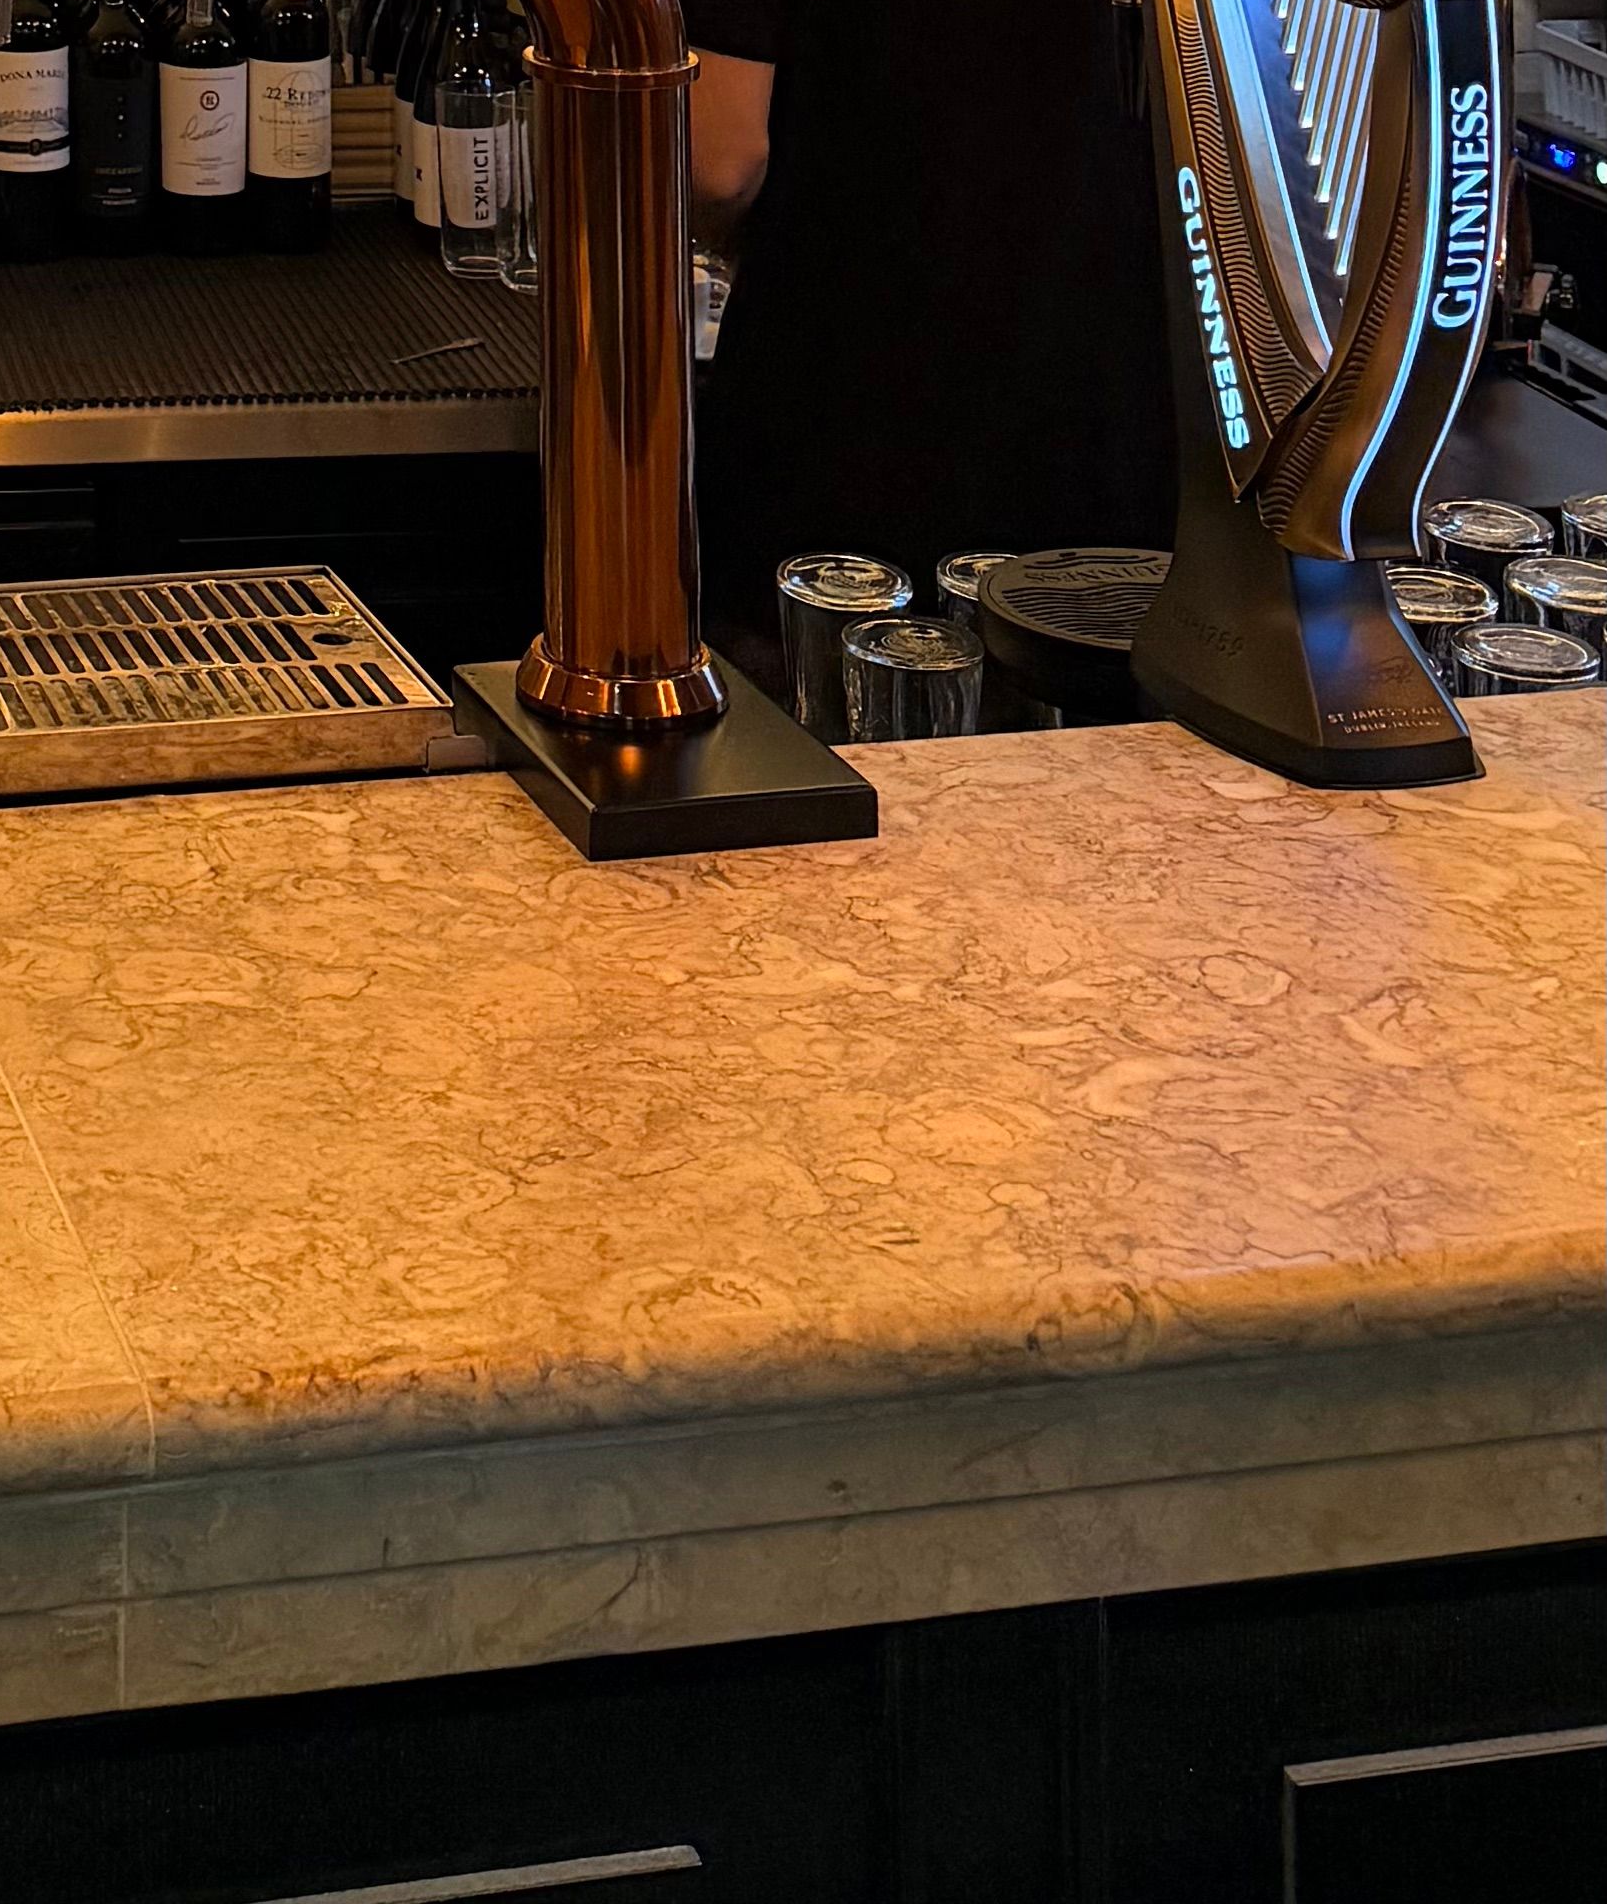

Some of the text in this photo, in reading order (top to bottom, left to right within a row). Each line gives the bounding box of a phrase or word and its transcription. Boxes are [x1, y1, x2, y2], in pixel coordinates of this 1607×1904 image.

[474, 137, 489, 221] EXPLICIT
[1431, 82, 1489, 329] GUINNESS
[1177, 165, 1251, 450] GUINNESS
[1327, 713, 1345, 724] ST
